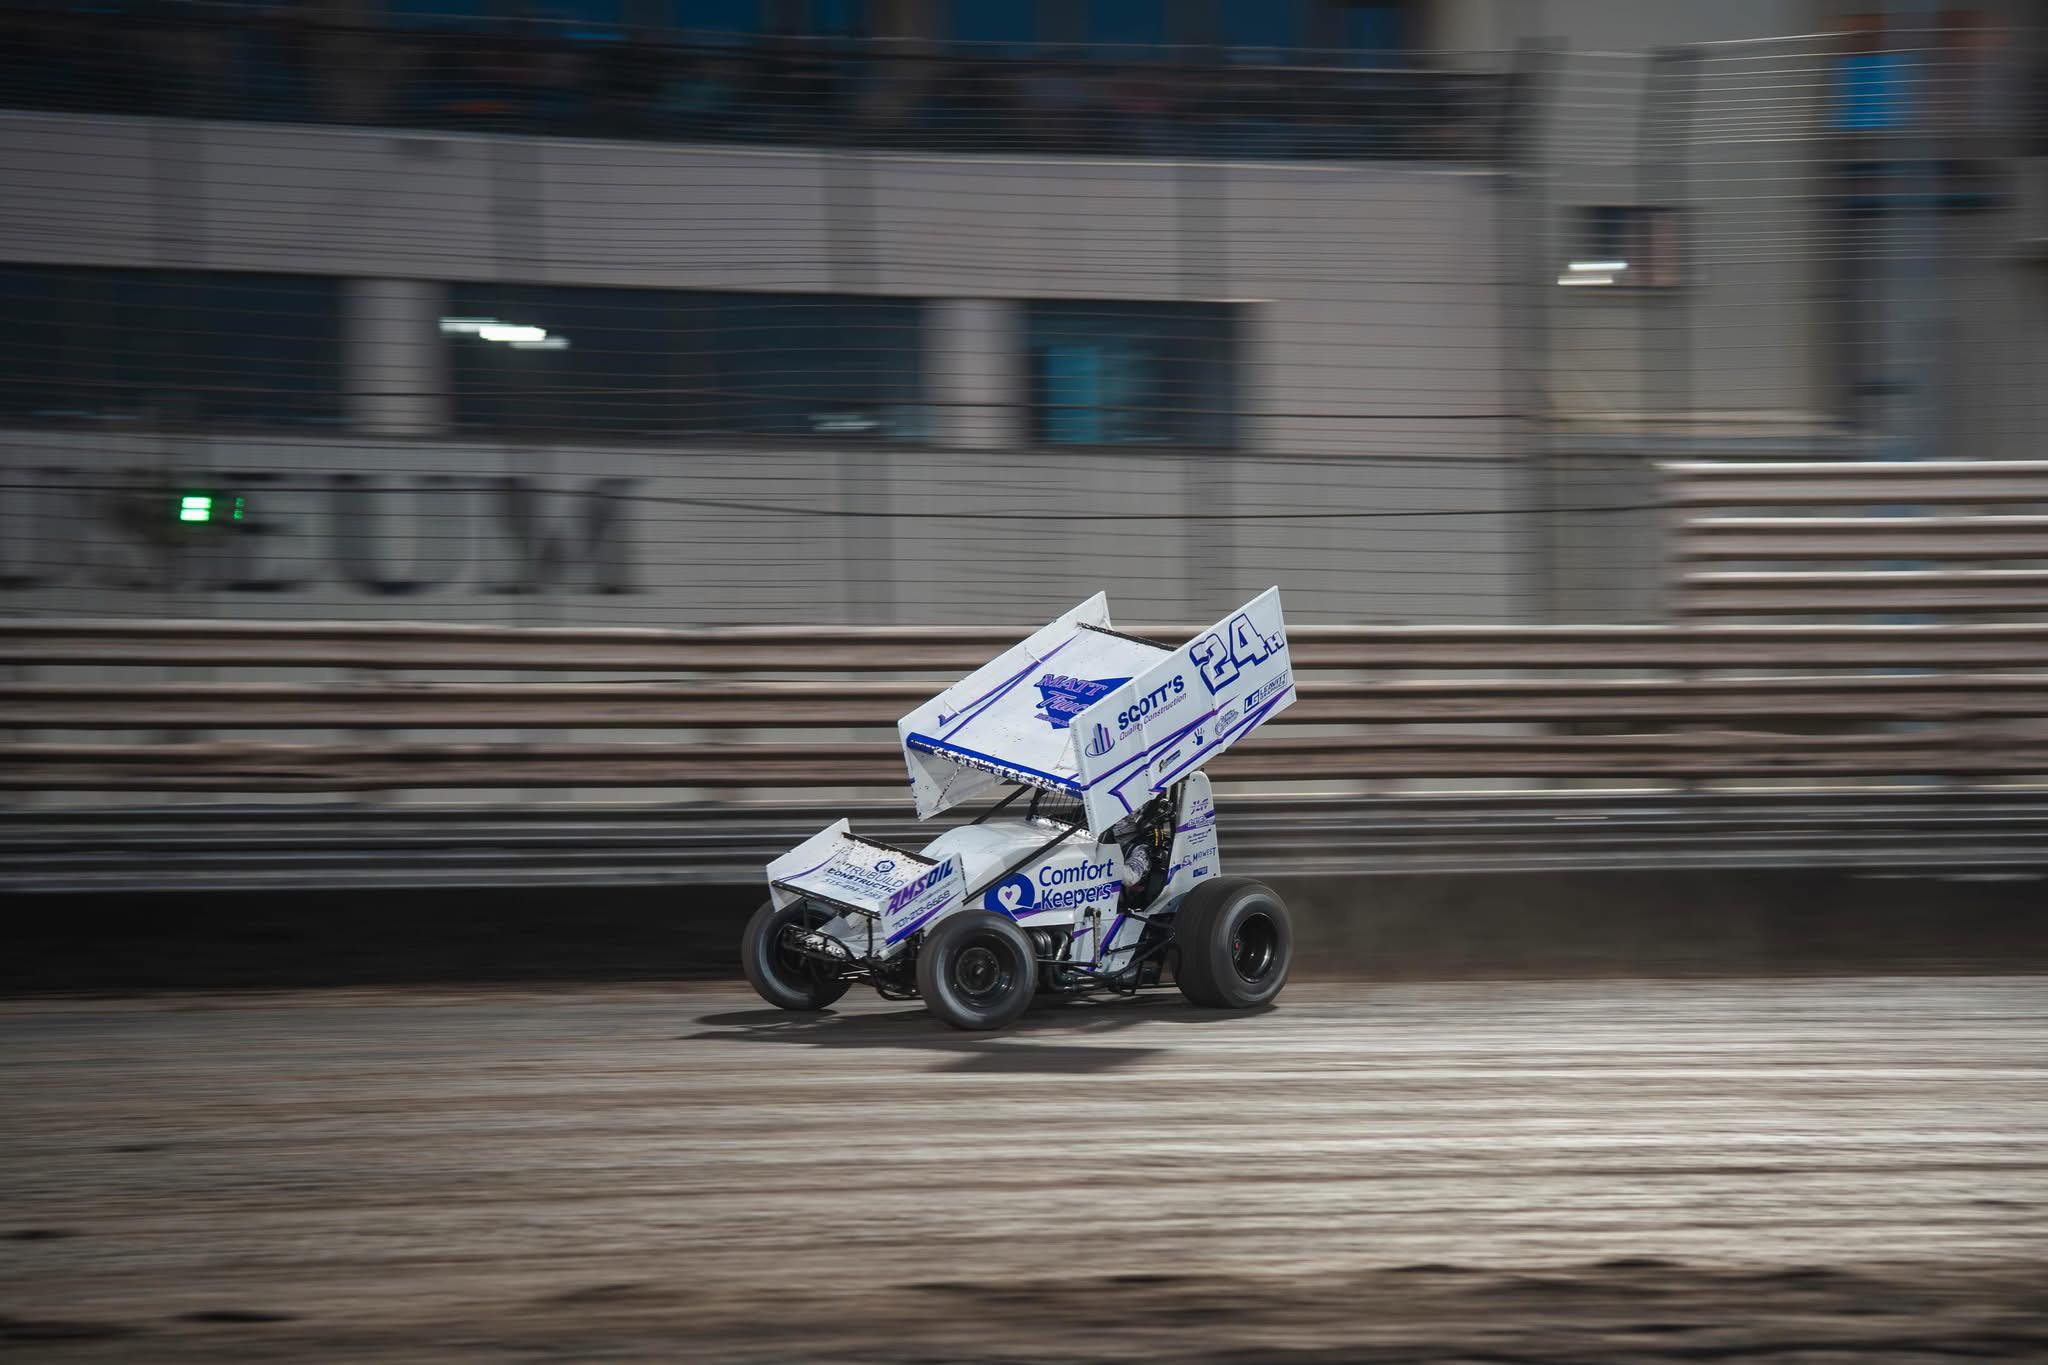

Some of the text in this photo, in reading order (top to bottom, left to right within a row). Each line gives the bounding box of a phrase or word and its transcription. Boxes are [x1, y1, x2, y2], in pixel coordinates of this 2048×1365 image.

[1034, 674, 1107, 696] MATT
[1117, 675, 1185, 731] SCOTT'S
[1119, 722, 1143, 741] Quality
[1143, 692, 1187, 725] Construction
[1193, 846, 1216, 863] MIDWEST
[845, 862, 905, 888] TRUBUILD
[1039, 858, 1114, 887] Comfort
[885, 858, 954, 917] AMSOIL
[1041, 885, 1112, 910] Keepers
